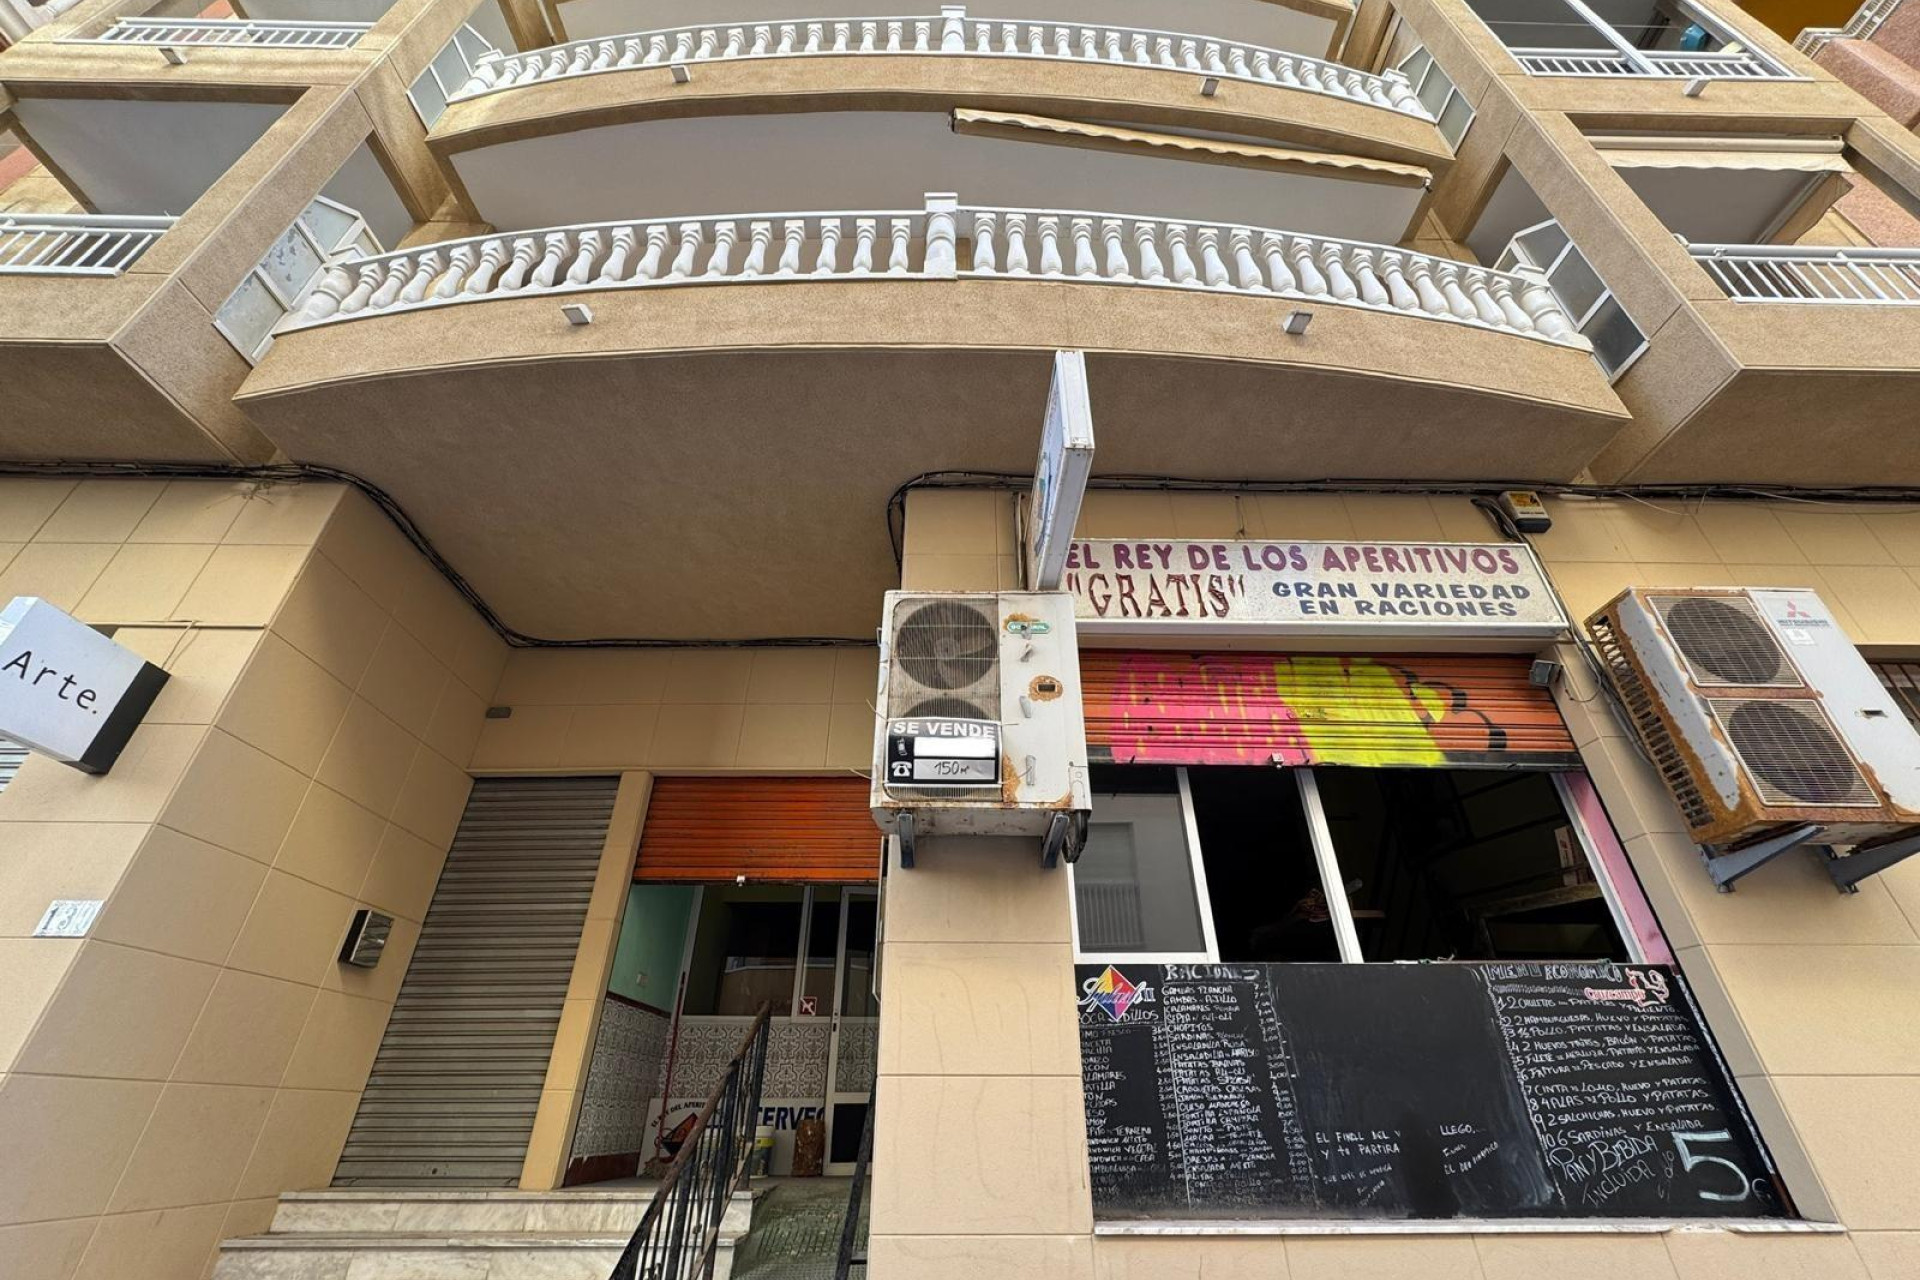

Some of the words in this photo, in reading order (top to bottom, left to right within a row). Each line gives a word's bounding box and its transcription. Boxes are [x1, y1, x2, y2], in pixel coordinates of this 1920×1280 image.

[1066, 543, 1100, 569] EL
[1113, 543, 1173, 570] REY
[1187, 544, 1231, 571] DE
[1241, 545, 1308, 571] LOS
[1322, 546, 1519, 575] APERITIVOS
[1272, 582, 1358, 598] GRAN
[1370, 582, 1531, 600] VARIEDAD
[1300, 599, 1339, 615] EN
[1355, 600, 1518, 617] RACIONES
[2, 650, 97, 715] Arte.
[893, 721, 919, 735] SE
[926, 721, 996, 740] VENDE
[1507, 996, 1520, 1009] 2
[1513, 1015, 1525, 1026] 2
[1522, 1041, 1531, 1052] 2
[1524, 1085, 1532, 1095] 7
[1534, 1084, 1570, 1096] CINTA
[1529, 1098, 1539, 1111] 8
[1541, 1097, 1551, 1110] 4
[1550, 1095, 1584, 1109] ALAS
[1597, 1091, 1637, 1104] POLLO
[1534, 1113, 1547, 1132] 9
[1547, 1113, 1558, 1127] 2
[1621, 1107, 1655, 1118] HUEVO
[1315, 1131, 1330, 1144] EL
[1557, 1129, 1568, 1146] 6
[1567, 1126, 1627, 1144] SARDINAS
[1634, 1123, 1642, 1132] Y
[1646, 1119, 1704, 1132] ENSALADA
[1549, 1147, 1591, 1183] PAN
[1671, 1128, 1750, 1202] 5
